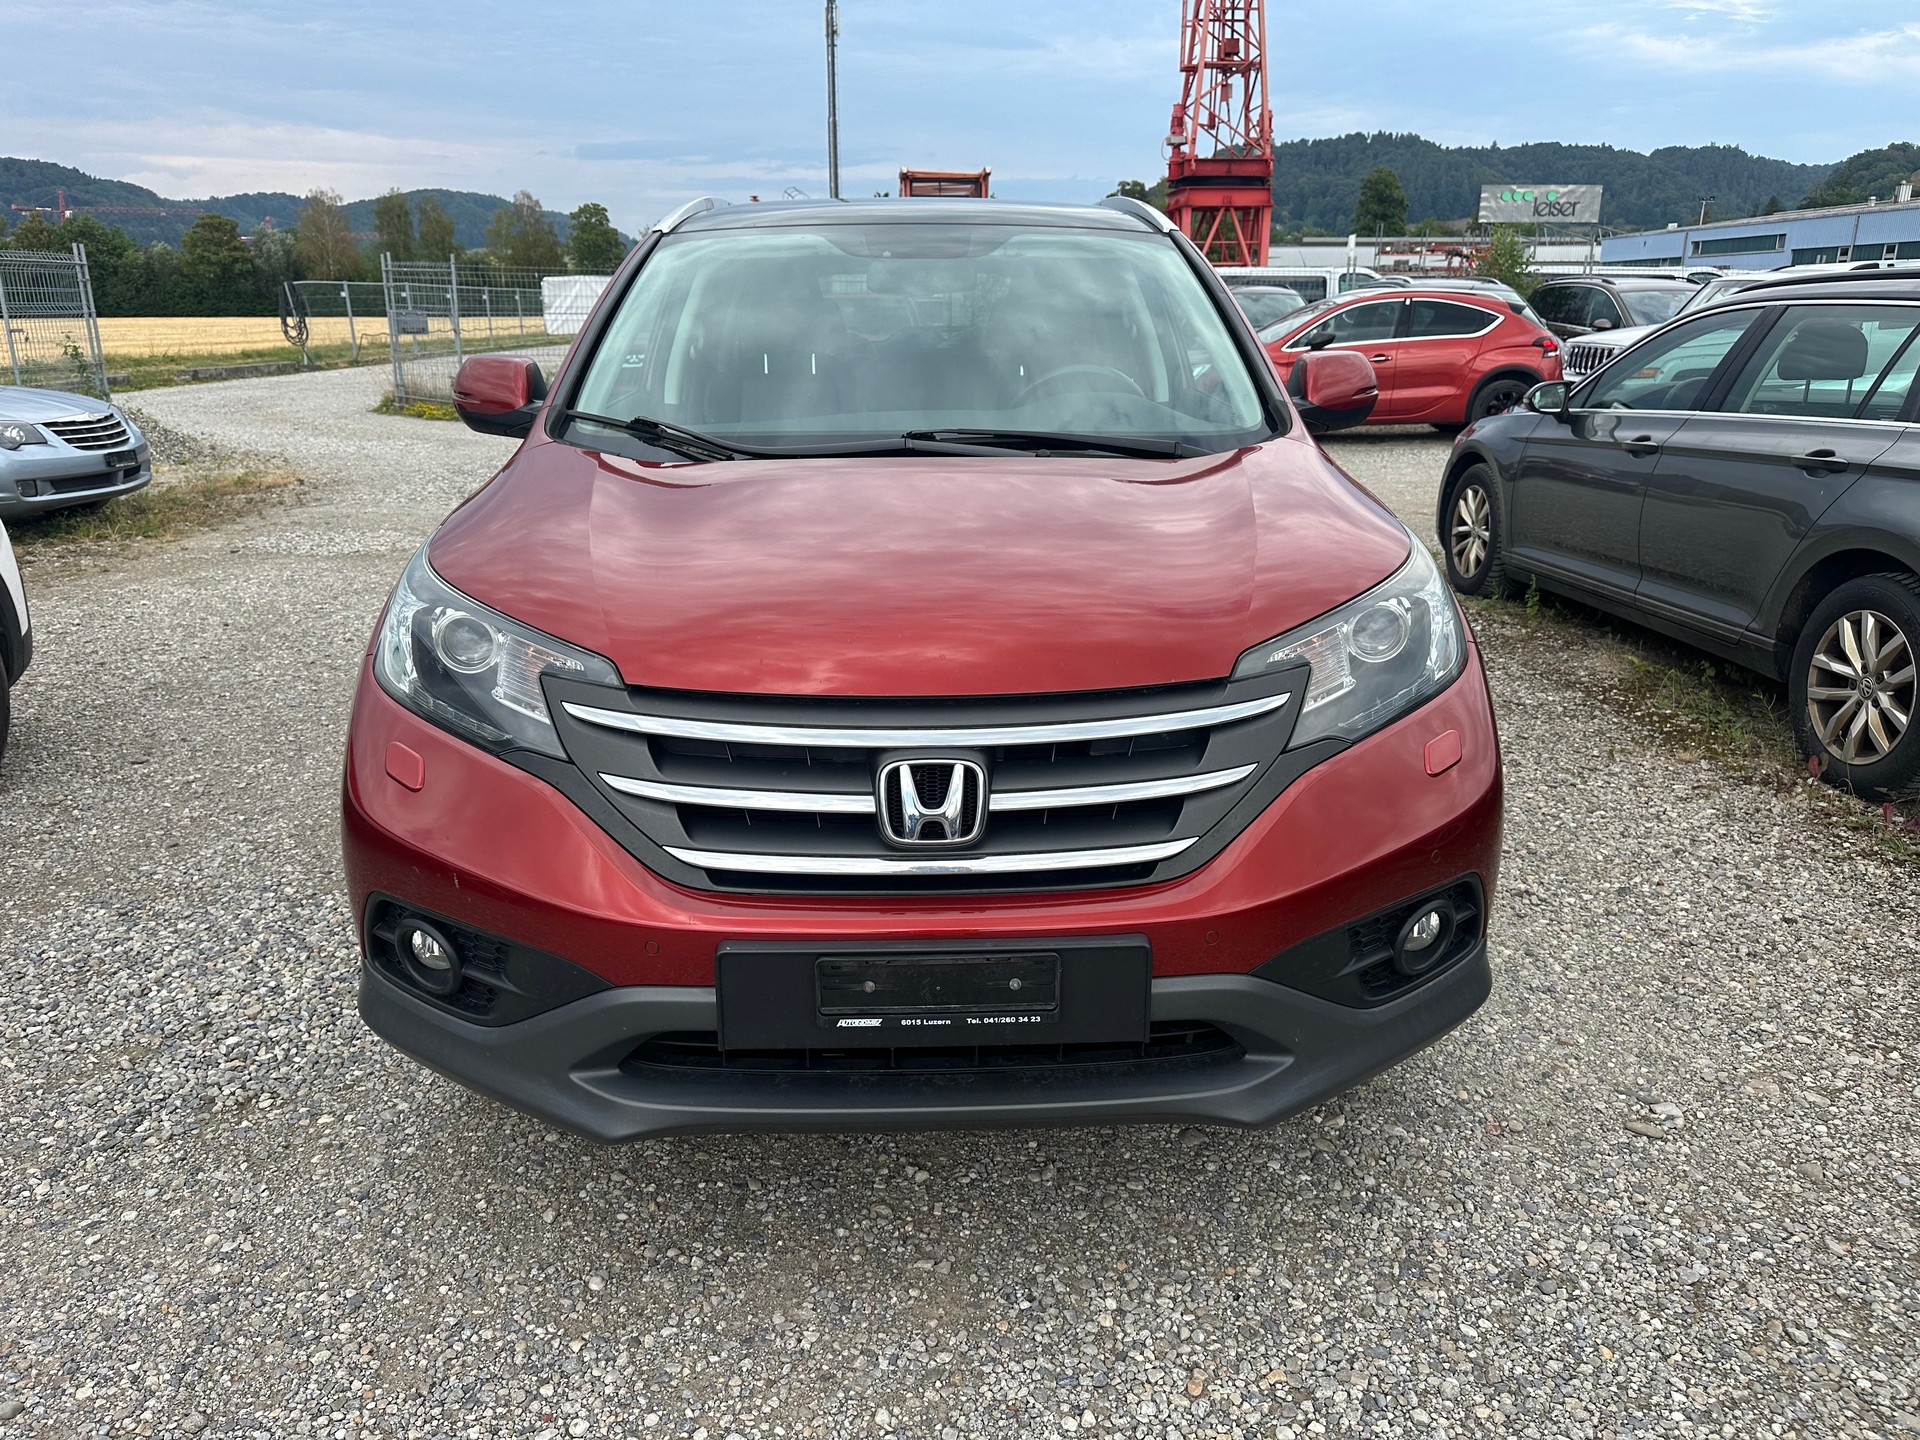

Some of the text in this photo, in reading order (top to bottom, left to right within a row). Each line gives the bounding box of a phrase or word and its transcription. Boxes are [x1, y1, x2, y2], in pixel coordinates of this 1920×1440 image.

[1532, 193, 1580, 217] leiser
[983, 1016, 1016, 1024] 041/260
[1017, 1015, 1029, 1023] 34
